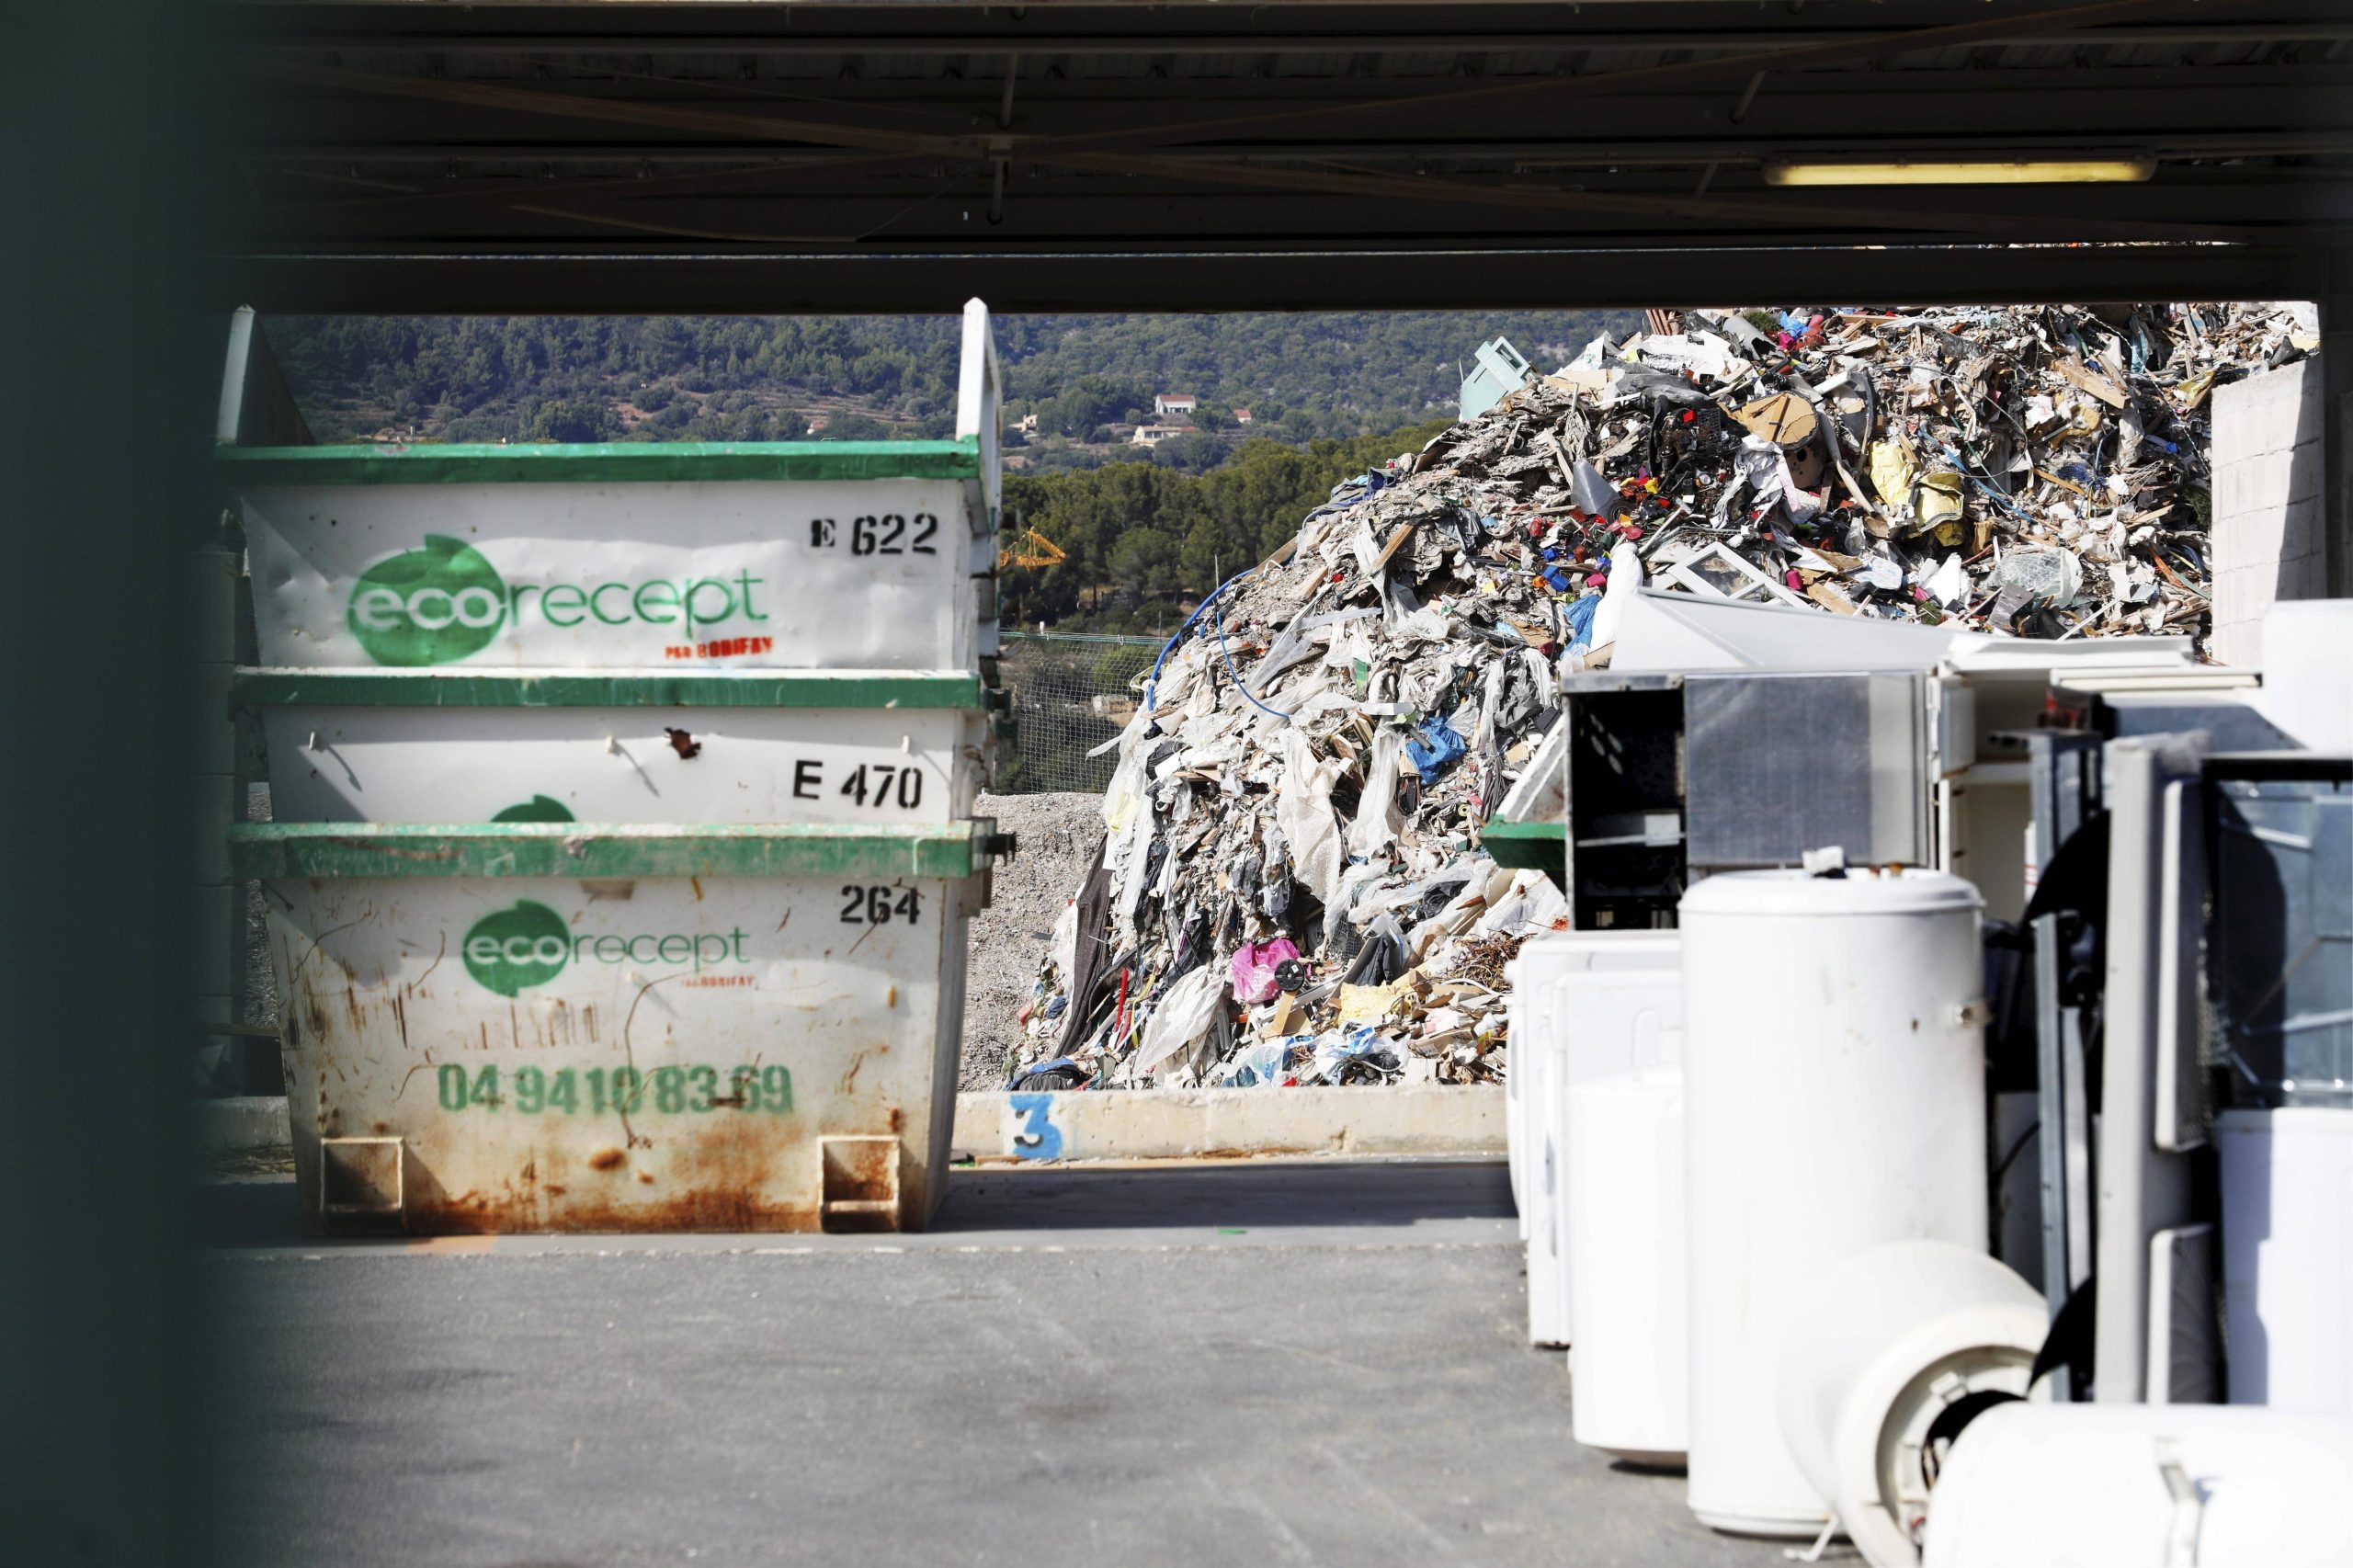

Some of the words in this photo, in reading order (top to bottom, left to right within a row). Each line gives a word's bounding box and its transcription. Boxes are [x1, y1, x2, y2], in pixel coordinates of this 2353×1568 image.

[810, 518, 835, 548] E
[851, 513, 938, 556] 622
[793, 759, 824, 801] E
[840, 764, 923, 810] 470
[839, 884, 921, 926] 264
[1009, 1094, 1062, 1162] 3
